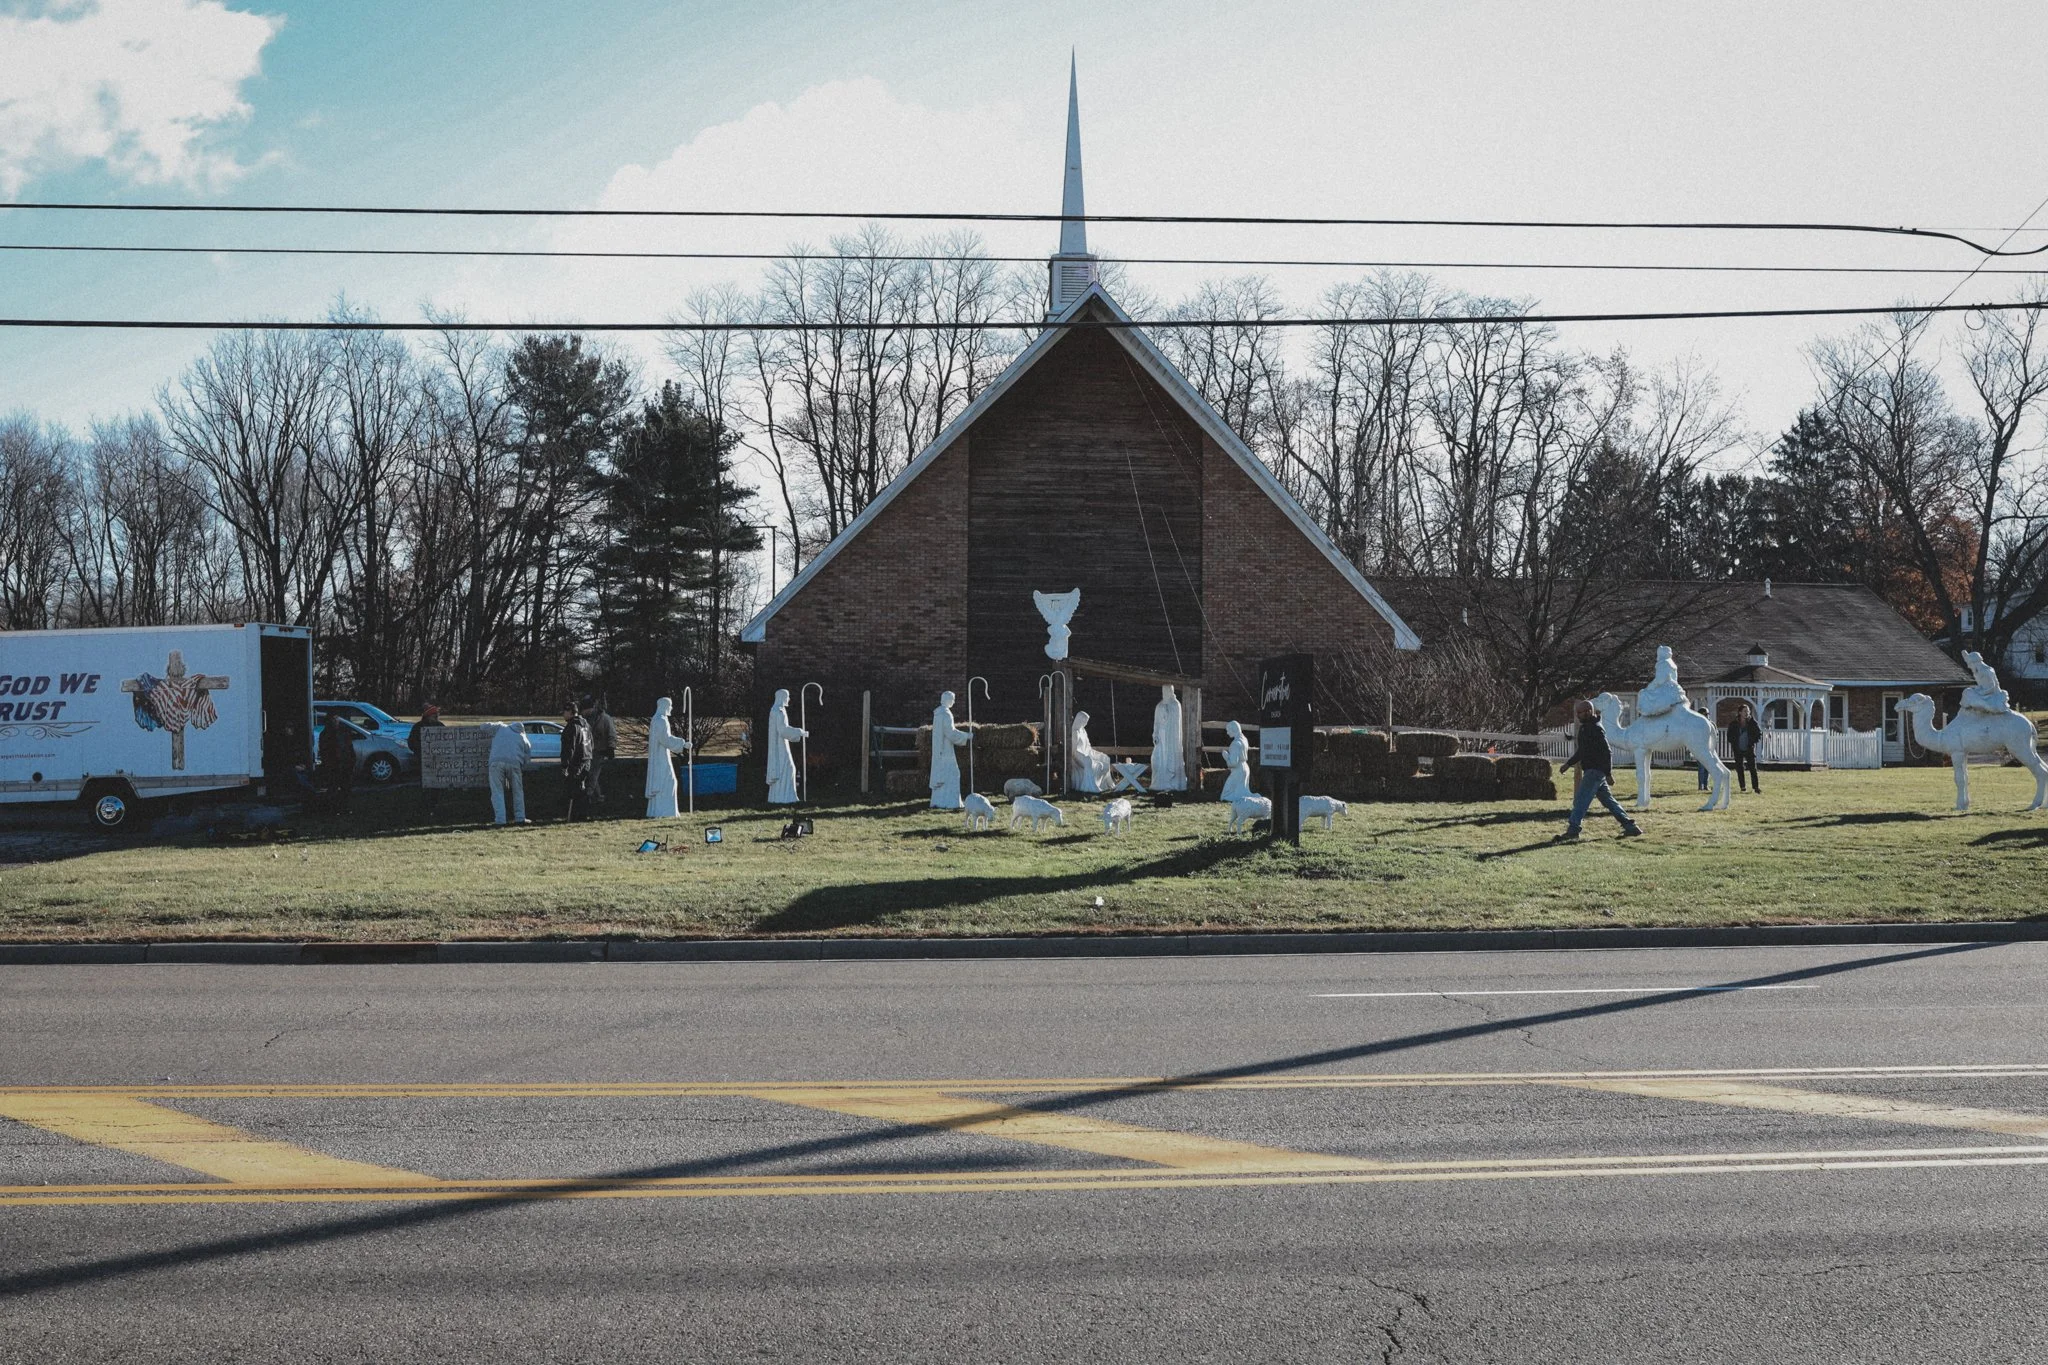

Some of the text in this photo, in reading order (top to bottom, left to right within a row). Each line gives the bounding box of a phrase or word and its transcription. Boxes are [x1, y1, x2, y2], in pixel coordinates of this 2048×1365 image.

[60, 673, 101, 694] WE
[423, 741, 452, 755] Jesus
[439, 759, 459, 769] save
